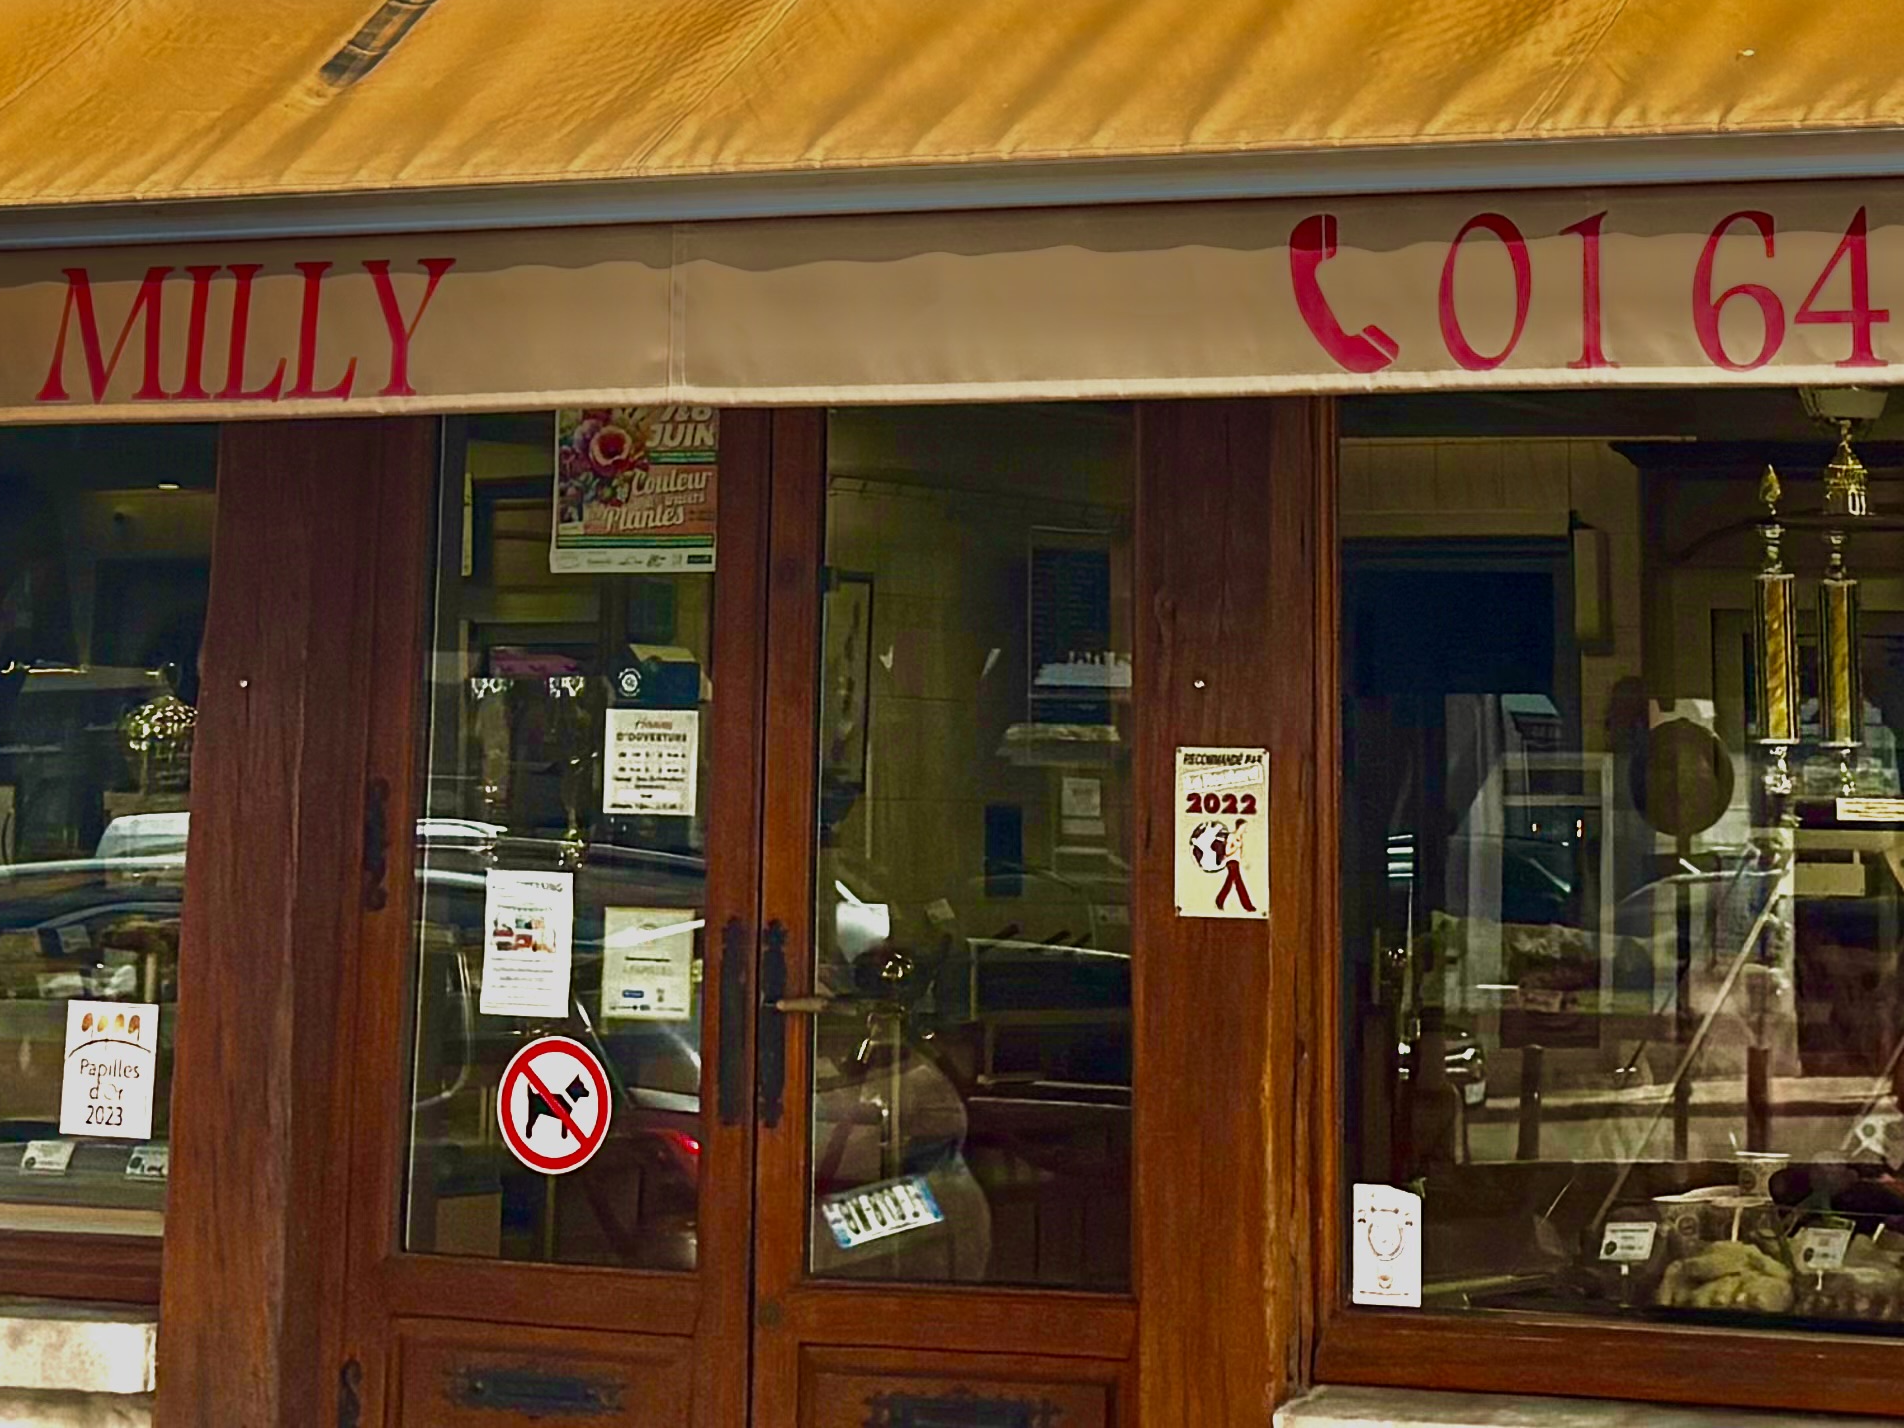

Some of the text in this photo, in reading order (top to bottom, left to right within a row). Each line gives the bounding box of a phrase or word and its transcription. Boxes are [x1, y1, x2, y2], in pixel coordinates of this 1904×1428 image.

[1438, 209, 1620, 372] 01
[1692, 206, 1890, 372] 64
[34, 258, 457, 403] MILLY
[647, 423, 716, 447] JUIN
[1185, 792, 1258, 815] 2022
[80, 1058, 141, 1085] Papilles
[86, 1105, 124, 1127] 2023
